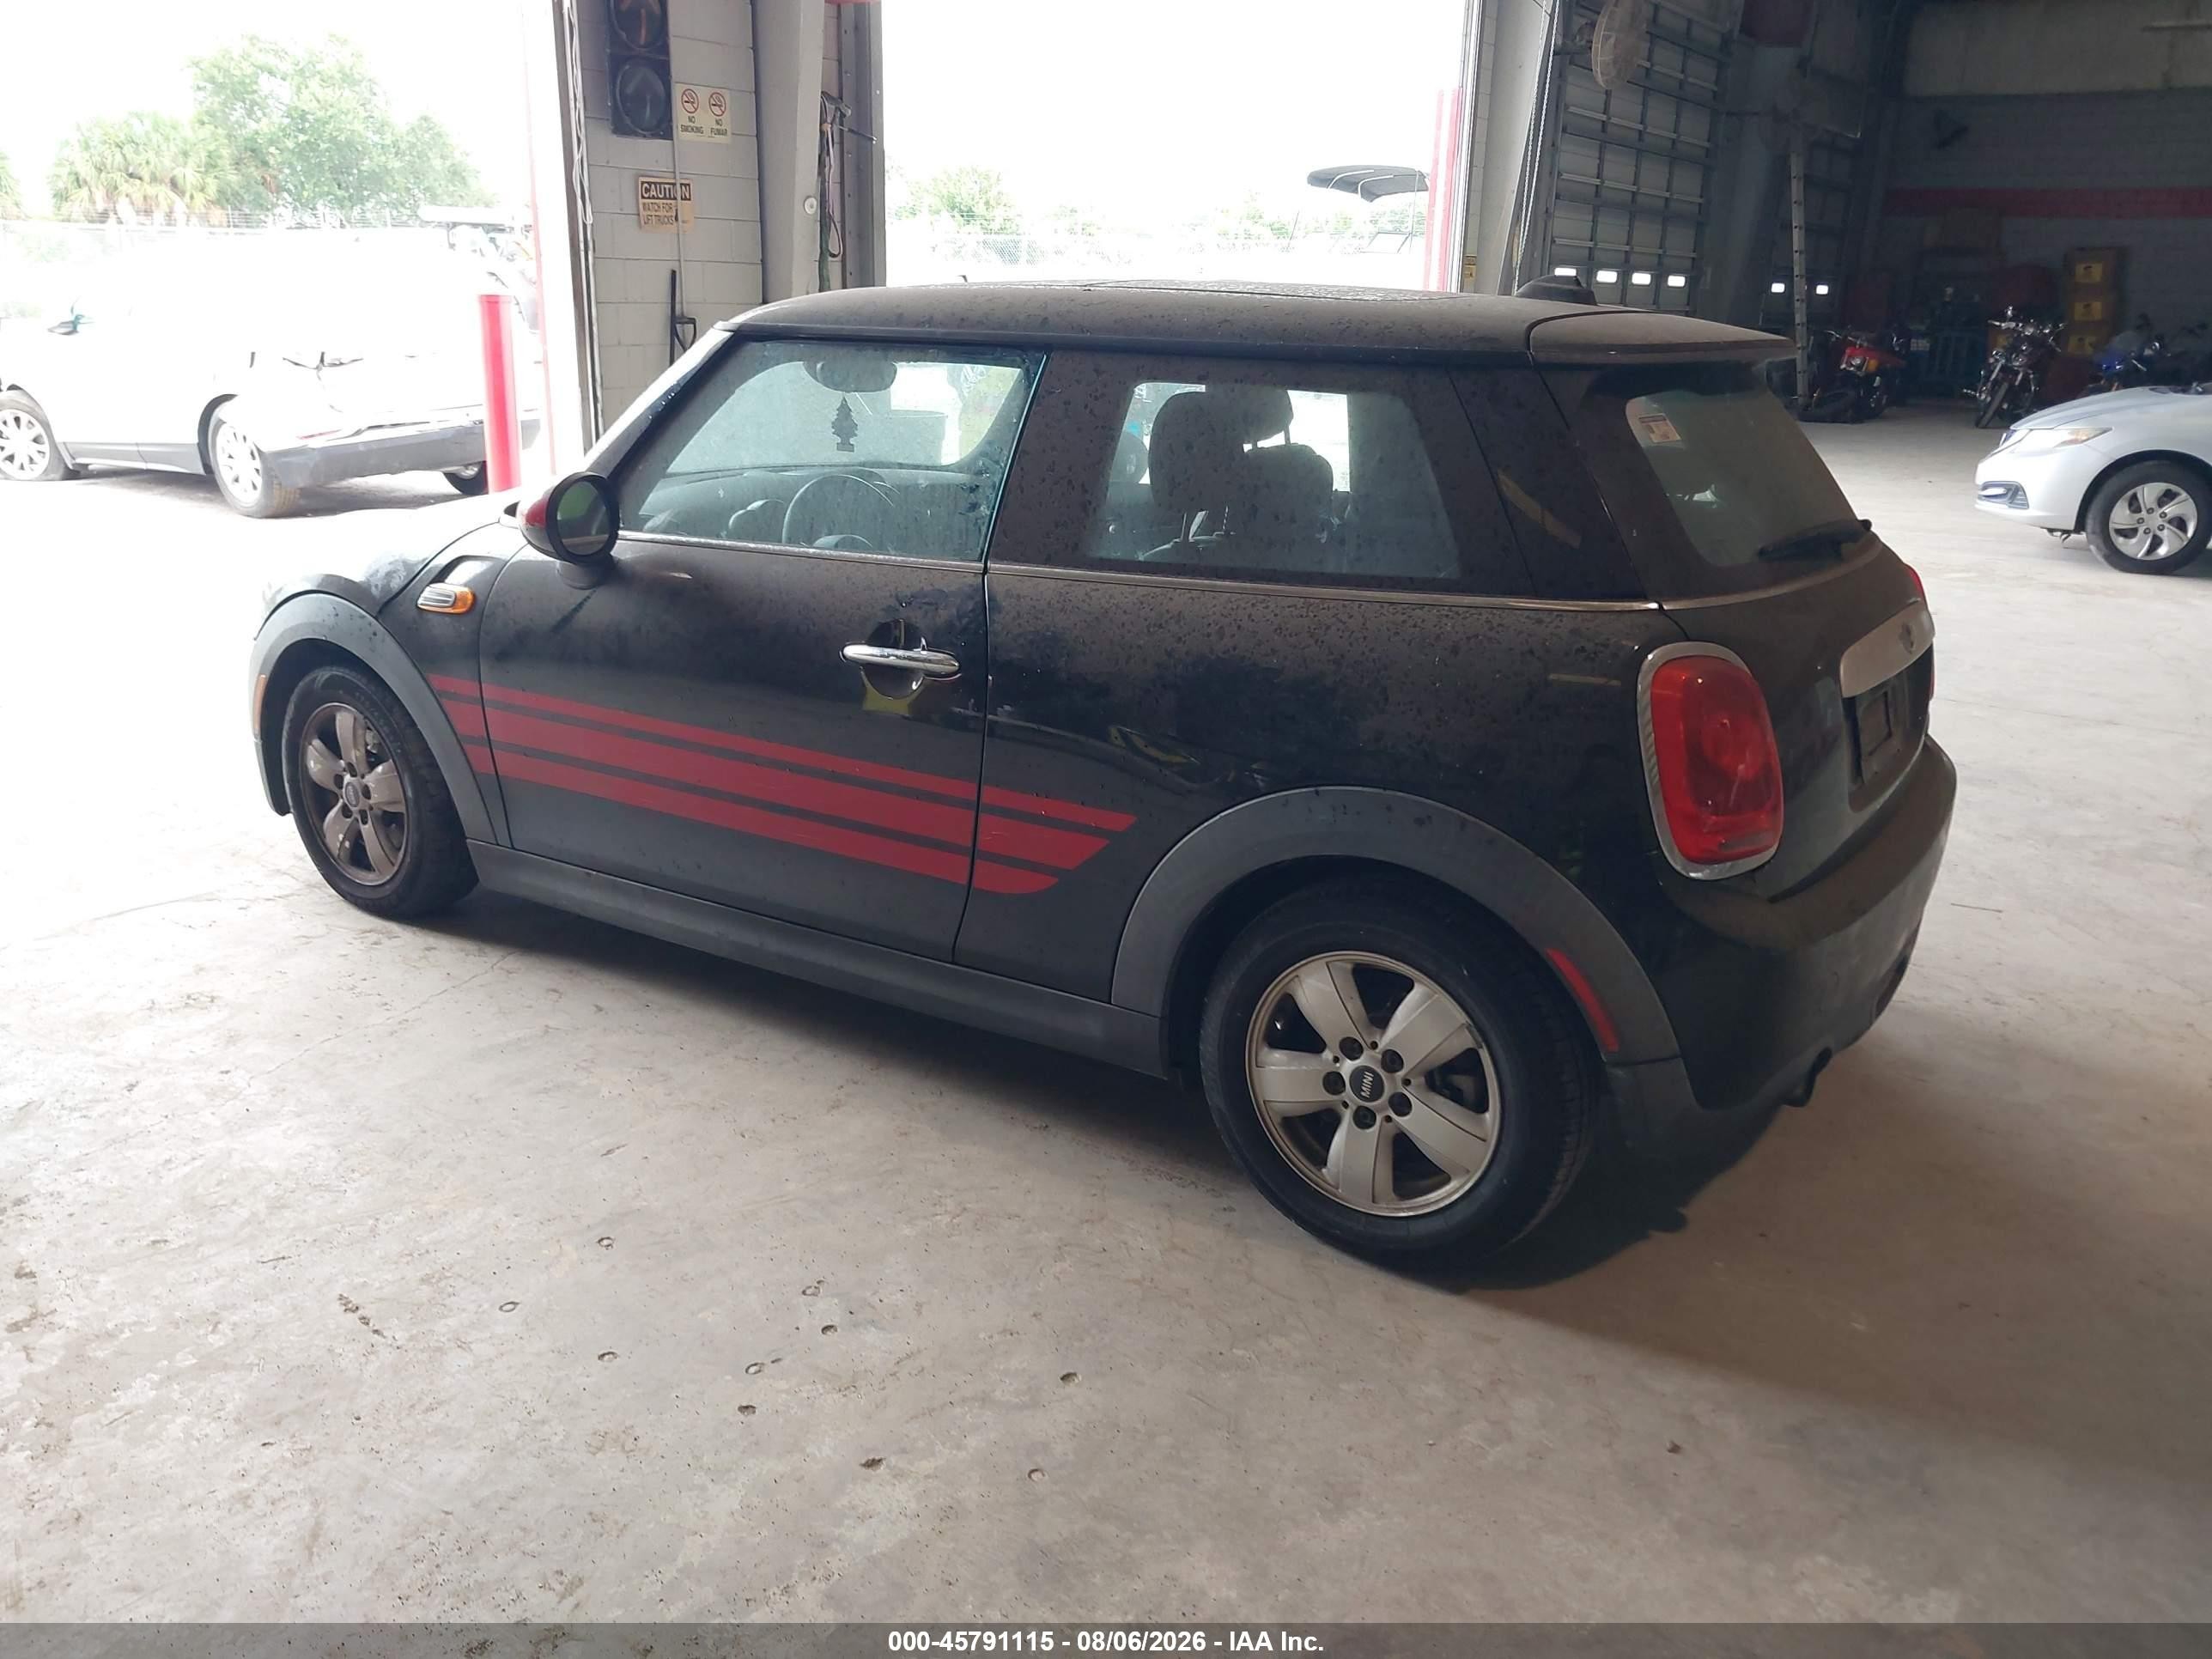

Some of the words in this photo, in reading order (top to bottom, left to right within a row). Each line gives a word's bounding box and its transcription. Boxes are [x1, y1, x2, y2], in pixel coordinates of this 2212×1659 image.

[680, 125, 704, 135] SMOKING
[710, 128, 728, 137] FUMAR
[1360, 1071, 1374, 1098] MINI
